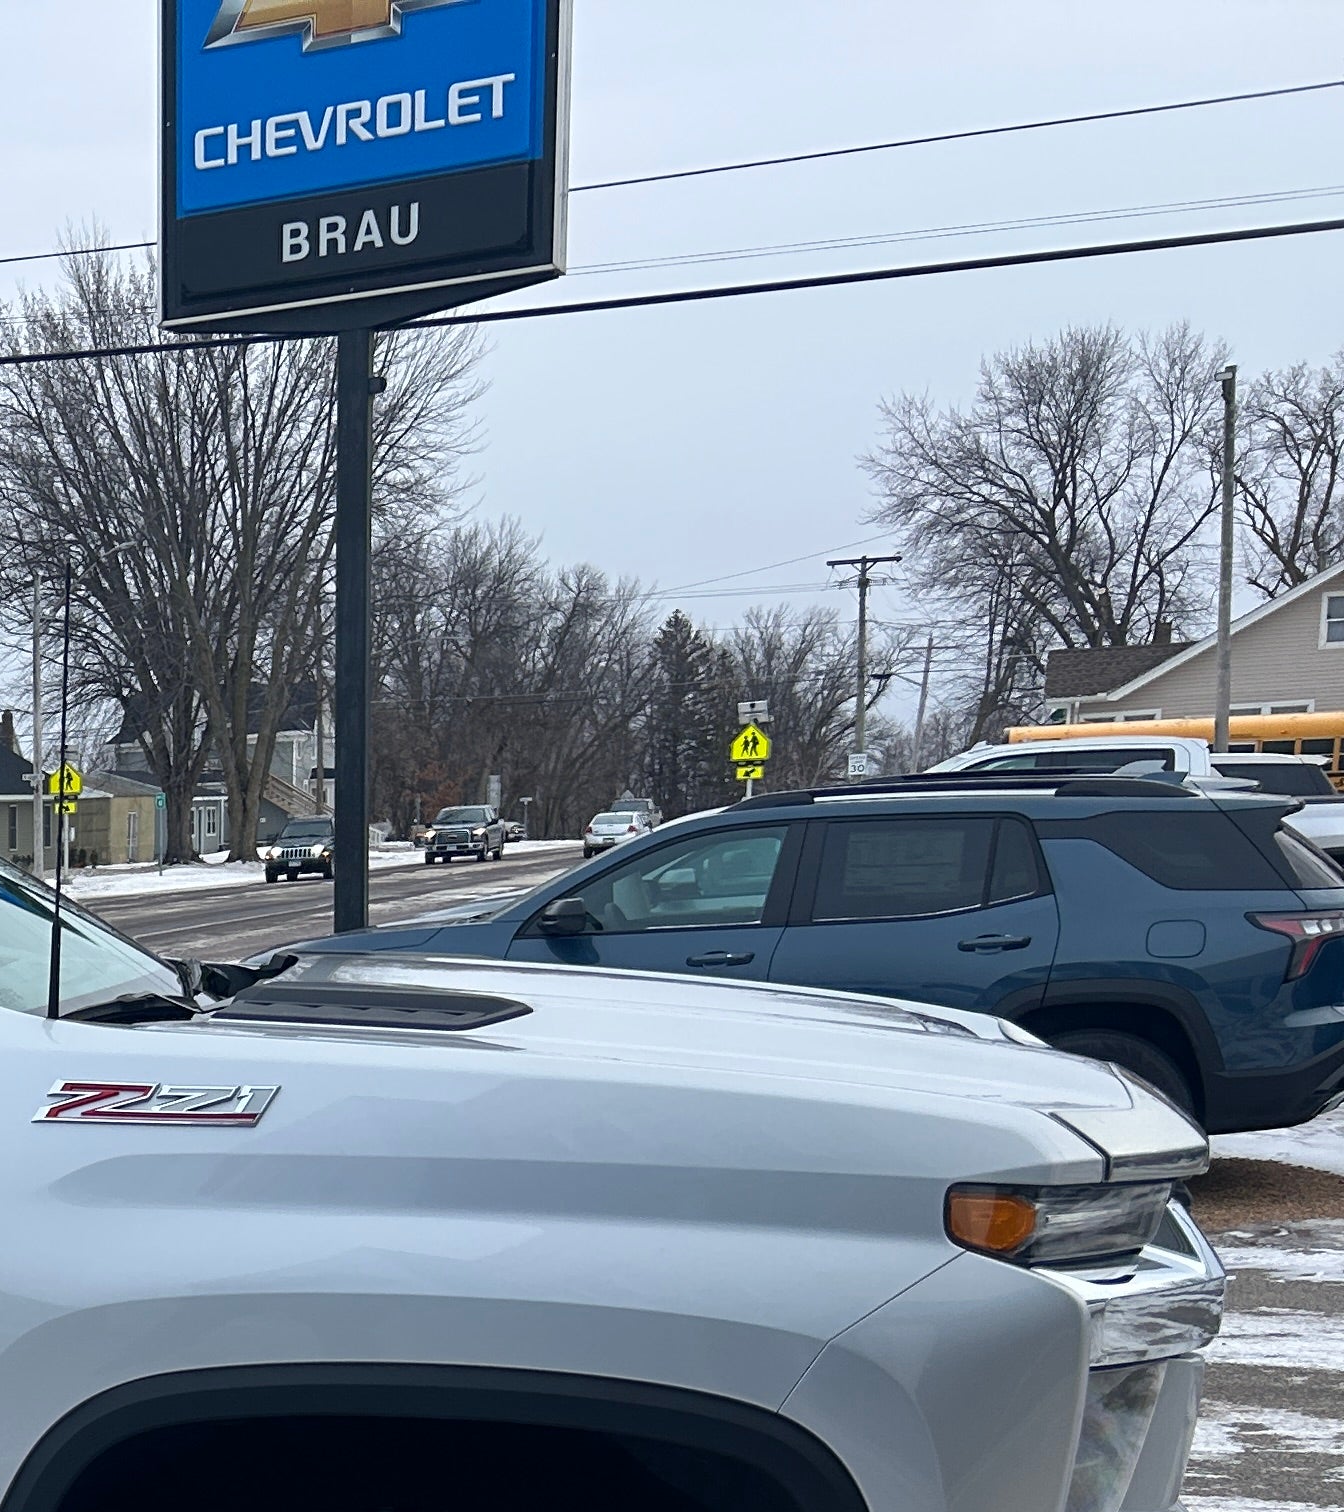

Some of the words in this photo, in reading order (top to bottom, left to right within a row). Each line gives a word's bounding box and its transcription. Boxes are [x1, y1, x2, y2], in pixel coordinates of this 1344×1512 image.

[193, 73, 516, 170] CHEVROLET
[280, 201, 420, 263] BRAU
[849, 764, 865, 773] 30
[30, 1079, 282, 1127] Z71
